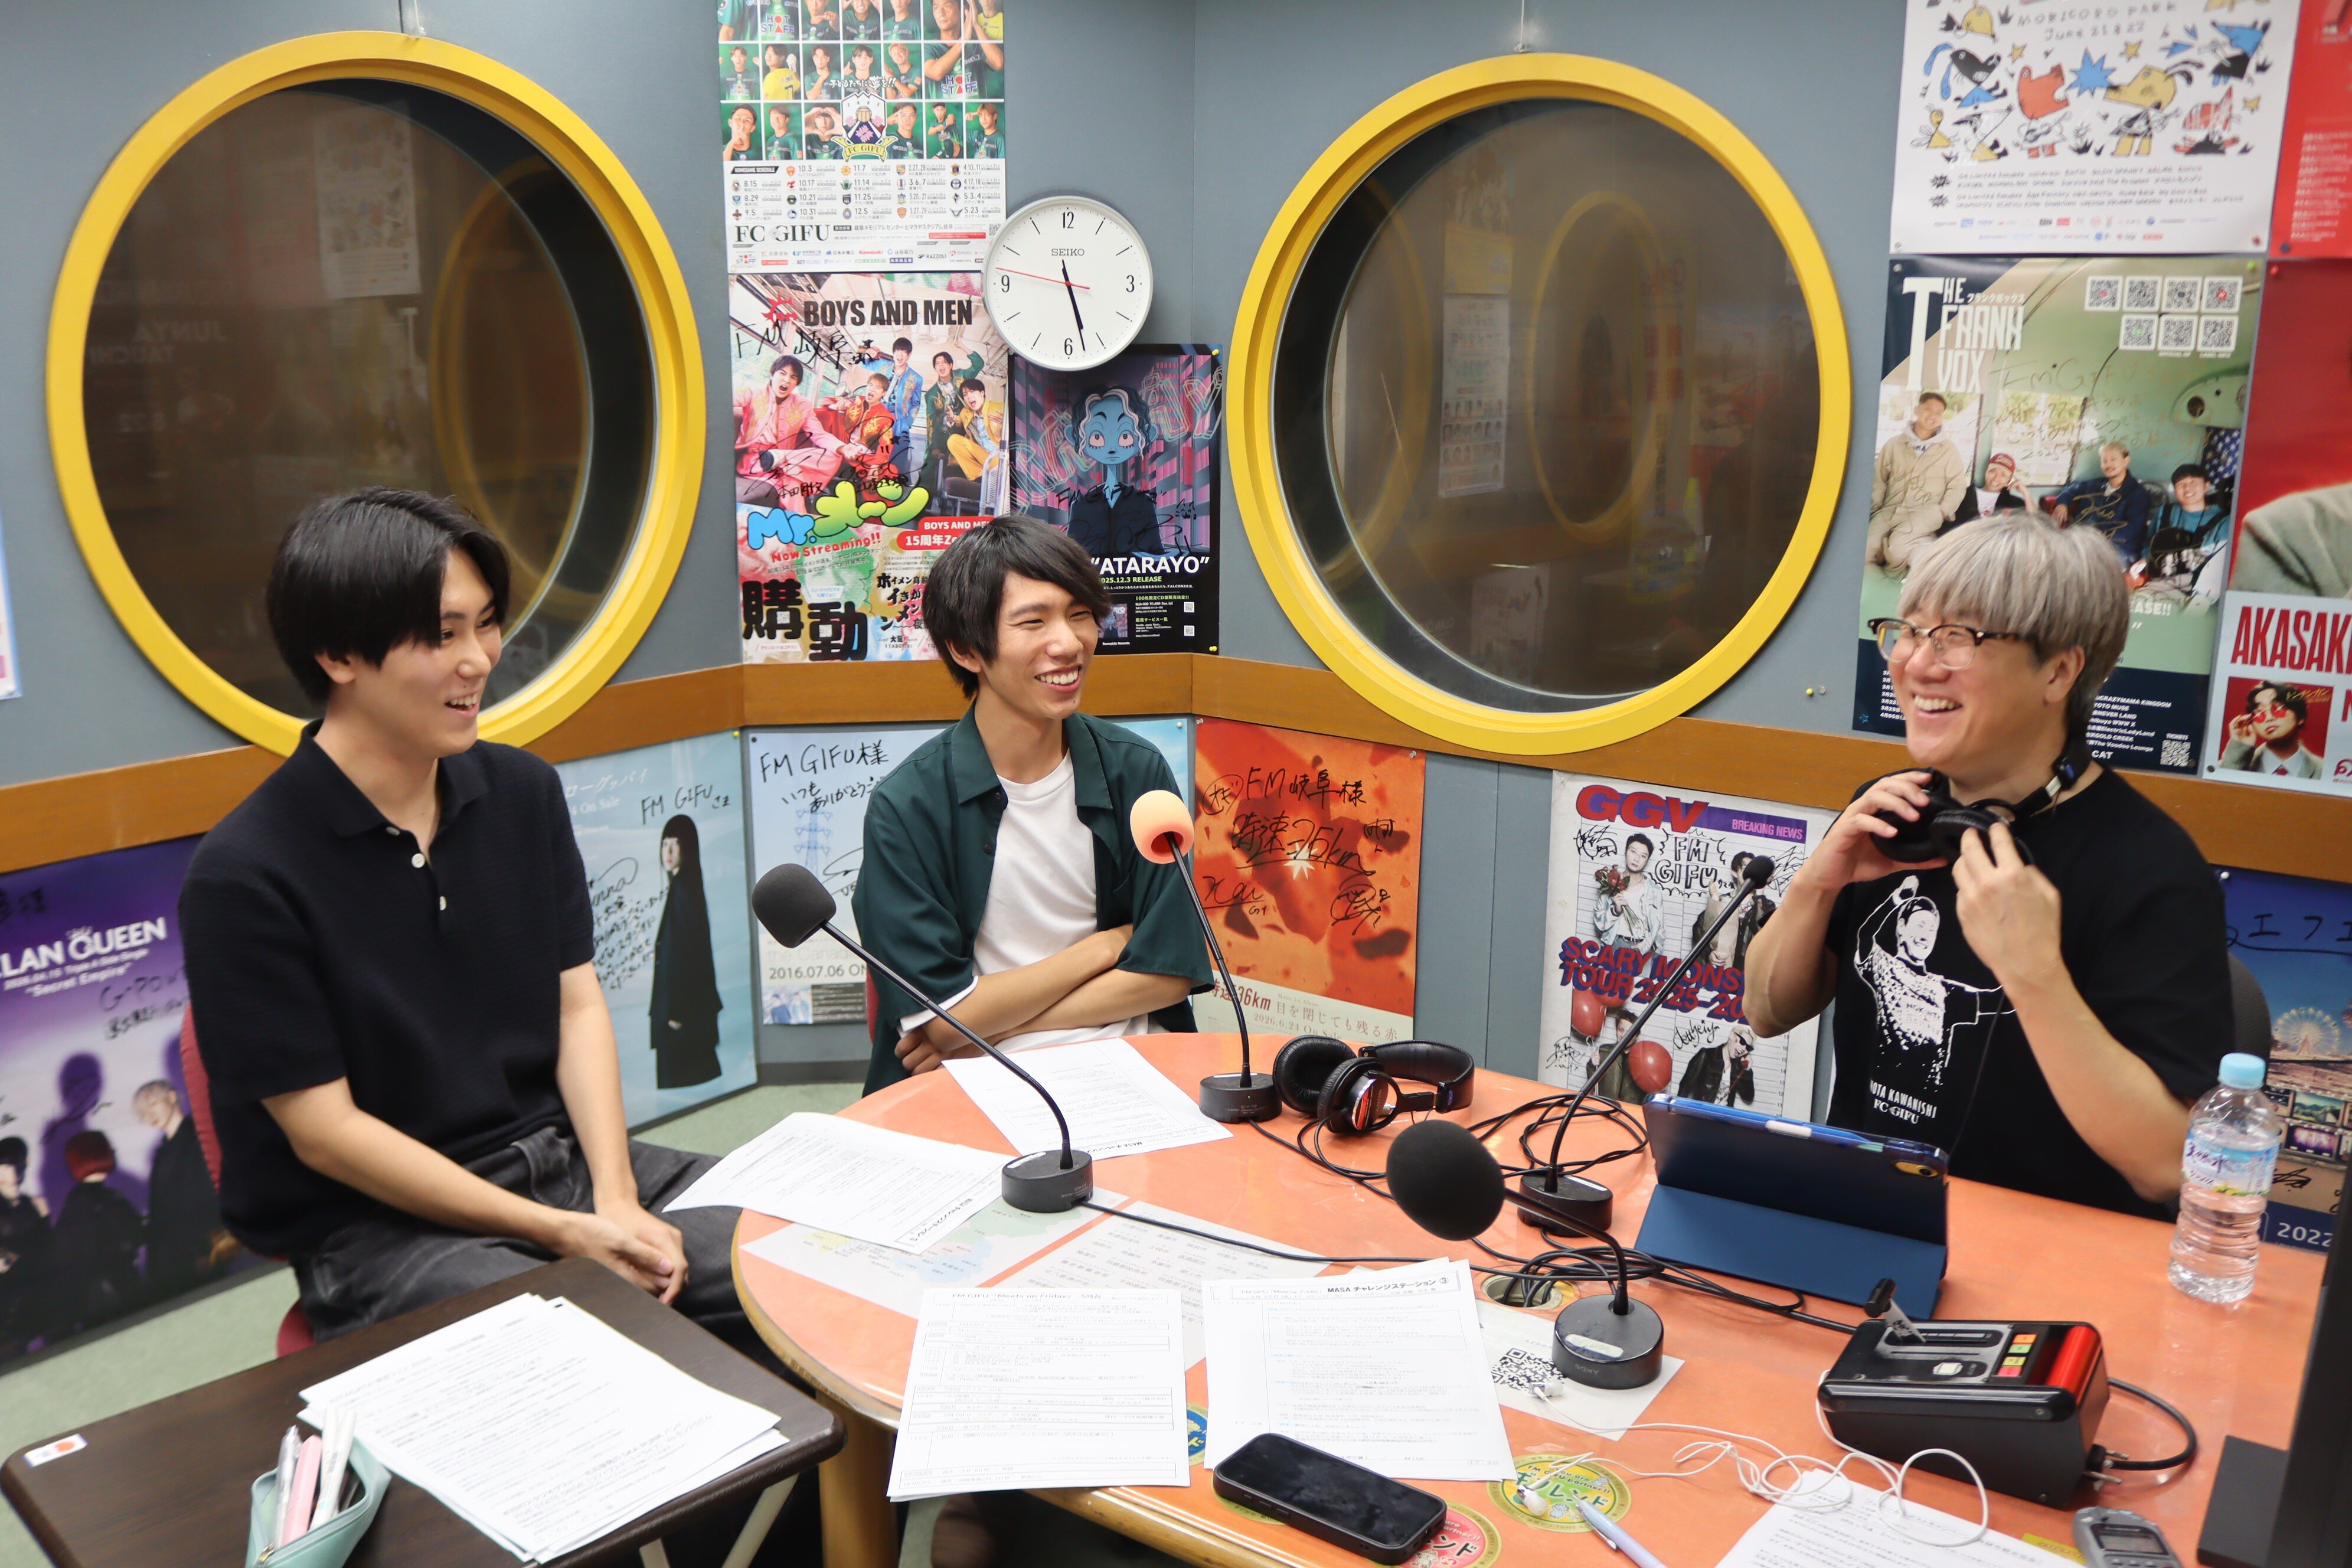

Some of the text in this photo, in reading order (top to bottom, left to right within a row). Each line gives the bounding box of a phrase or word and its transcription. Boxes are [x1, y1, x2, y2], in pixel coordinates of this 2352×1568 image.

[734, 224, 831, 243] FC GIFU
[1061, 211, 1074, 229] 12
[1001, 275, 1010, 293] 9
[1125, 275, 1135, 293] 3
[803, 299, 972, 327] BOYS AND MEN
[1937, 305, 2026, 351] FRANK
[1064, 338, 1073, 355] 6
[1936, 350, 1983, 394] VOX
[924, 521, 949, 530] BOYS
[950, 521, 971, 529] AND
[770, 531, 881, 563] Now Streaming!!
[759, 752, 793, 783] FM
[2090, 750, 2114, 760] CAT
[1575, 784, 1710, 834] GGV
[1732, 818, 1804, 841] BREAKING NEWS
[1672, 835, 1711, 863] FM
[1654, 860, 1719, 890] GIFU
[67, 916, 168, 961] QUEEN
[769, 965, 845, 980] 2016.07.06
[1559, 960, 1636, 999] TOUR
[1562, 936, 1745, 995] SCARY MONS
[1276, 1001, 1399, 1041] 目を閉じても残る赤
[1303, 1024, 1319, 1037] On
[1873, 1097, 1920, 1125] FC GIFU
[1888, 1088, 1937, 1119] KAWANISHI
[1353, 1279, 1436, 1292] チャレンジステーション
[1439, 1276, 1449, 1285] ③
[1574, 1363, 1599, 1376] SONY
[1527, 1464, 1611, 1494] FM GFU partner!!
